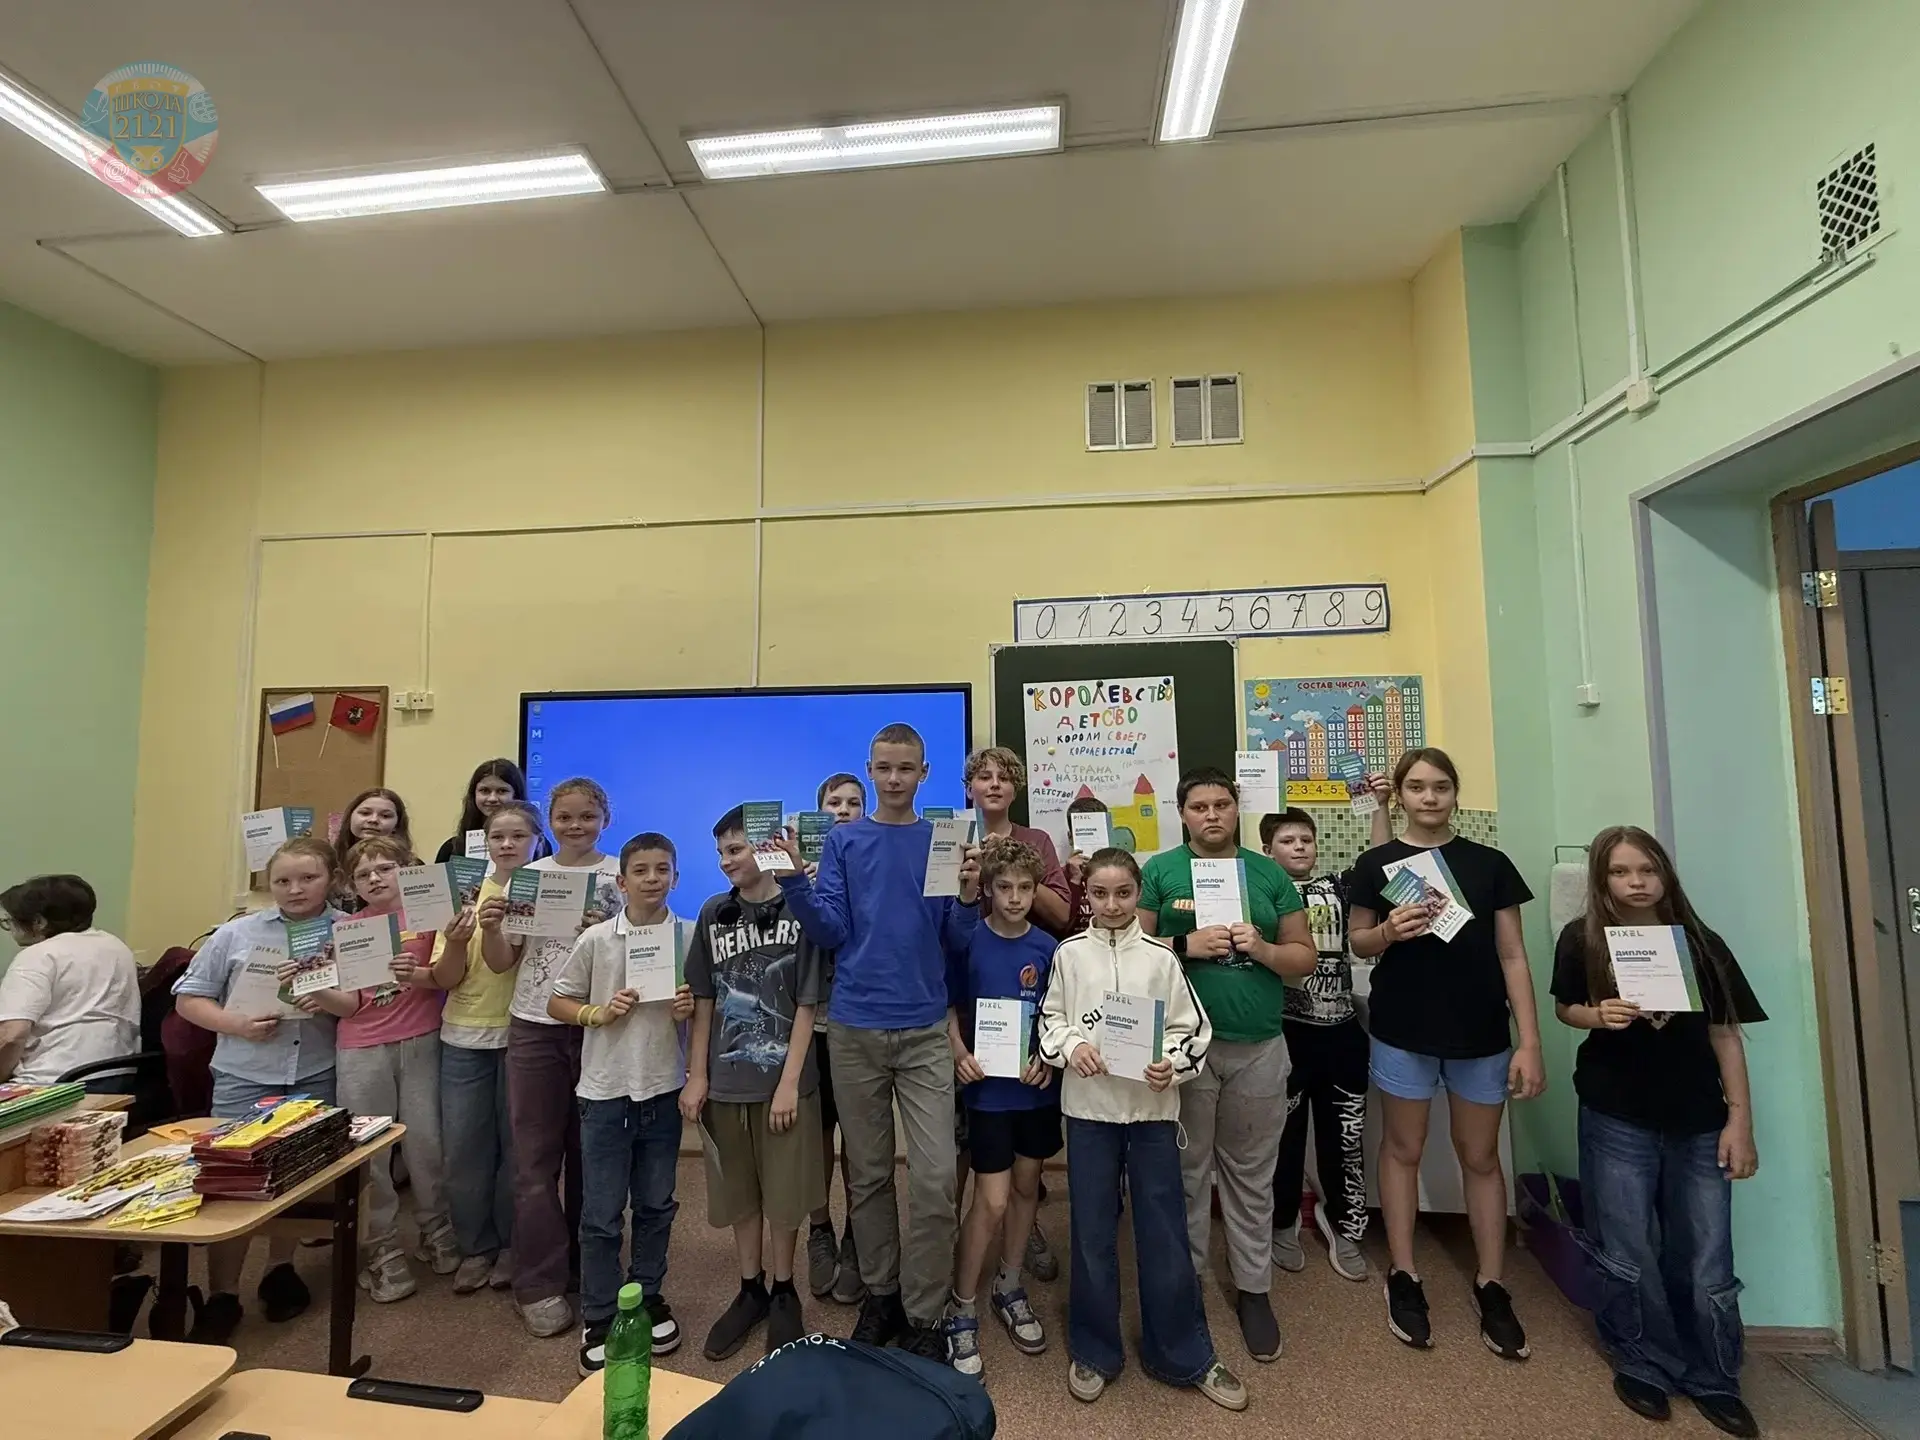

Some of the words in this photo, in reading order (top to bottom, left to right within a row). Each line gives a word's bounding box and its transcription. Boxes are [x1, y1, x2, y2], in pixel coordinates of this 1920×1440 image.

[1036, 605, 1056, 639] 0
[1078, 604, 1090, 637] 1
[1108, 602, 1126, 636] 2
[1143, 601, 1162, 634] 3
[1182, 598, 1198, 632] 4
[1214, 597, 1234, 631] 5
[1250, 596, 1270, 629] 6
[1287, 593, 1306, 628] 7
[1324, 591, 1344, 627] 8
[1362, 590, 1382, 625] 9
[1033, 684, 1173, 711] КОРОЛЕВСТВО
[1287, 785, 1293, 794] 2
[1301, 785, 1308, 794] 3
[1316, 785, 1322, 794] 4
[1330, 785, 1337, 794] 5
[1106, 994, 1132, 1005] PIXEL
[1106, 1014, 1138, 1025] ДИПЛОМ
